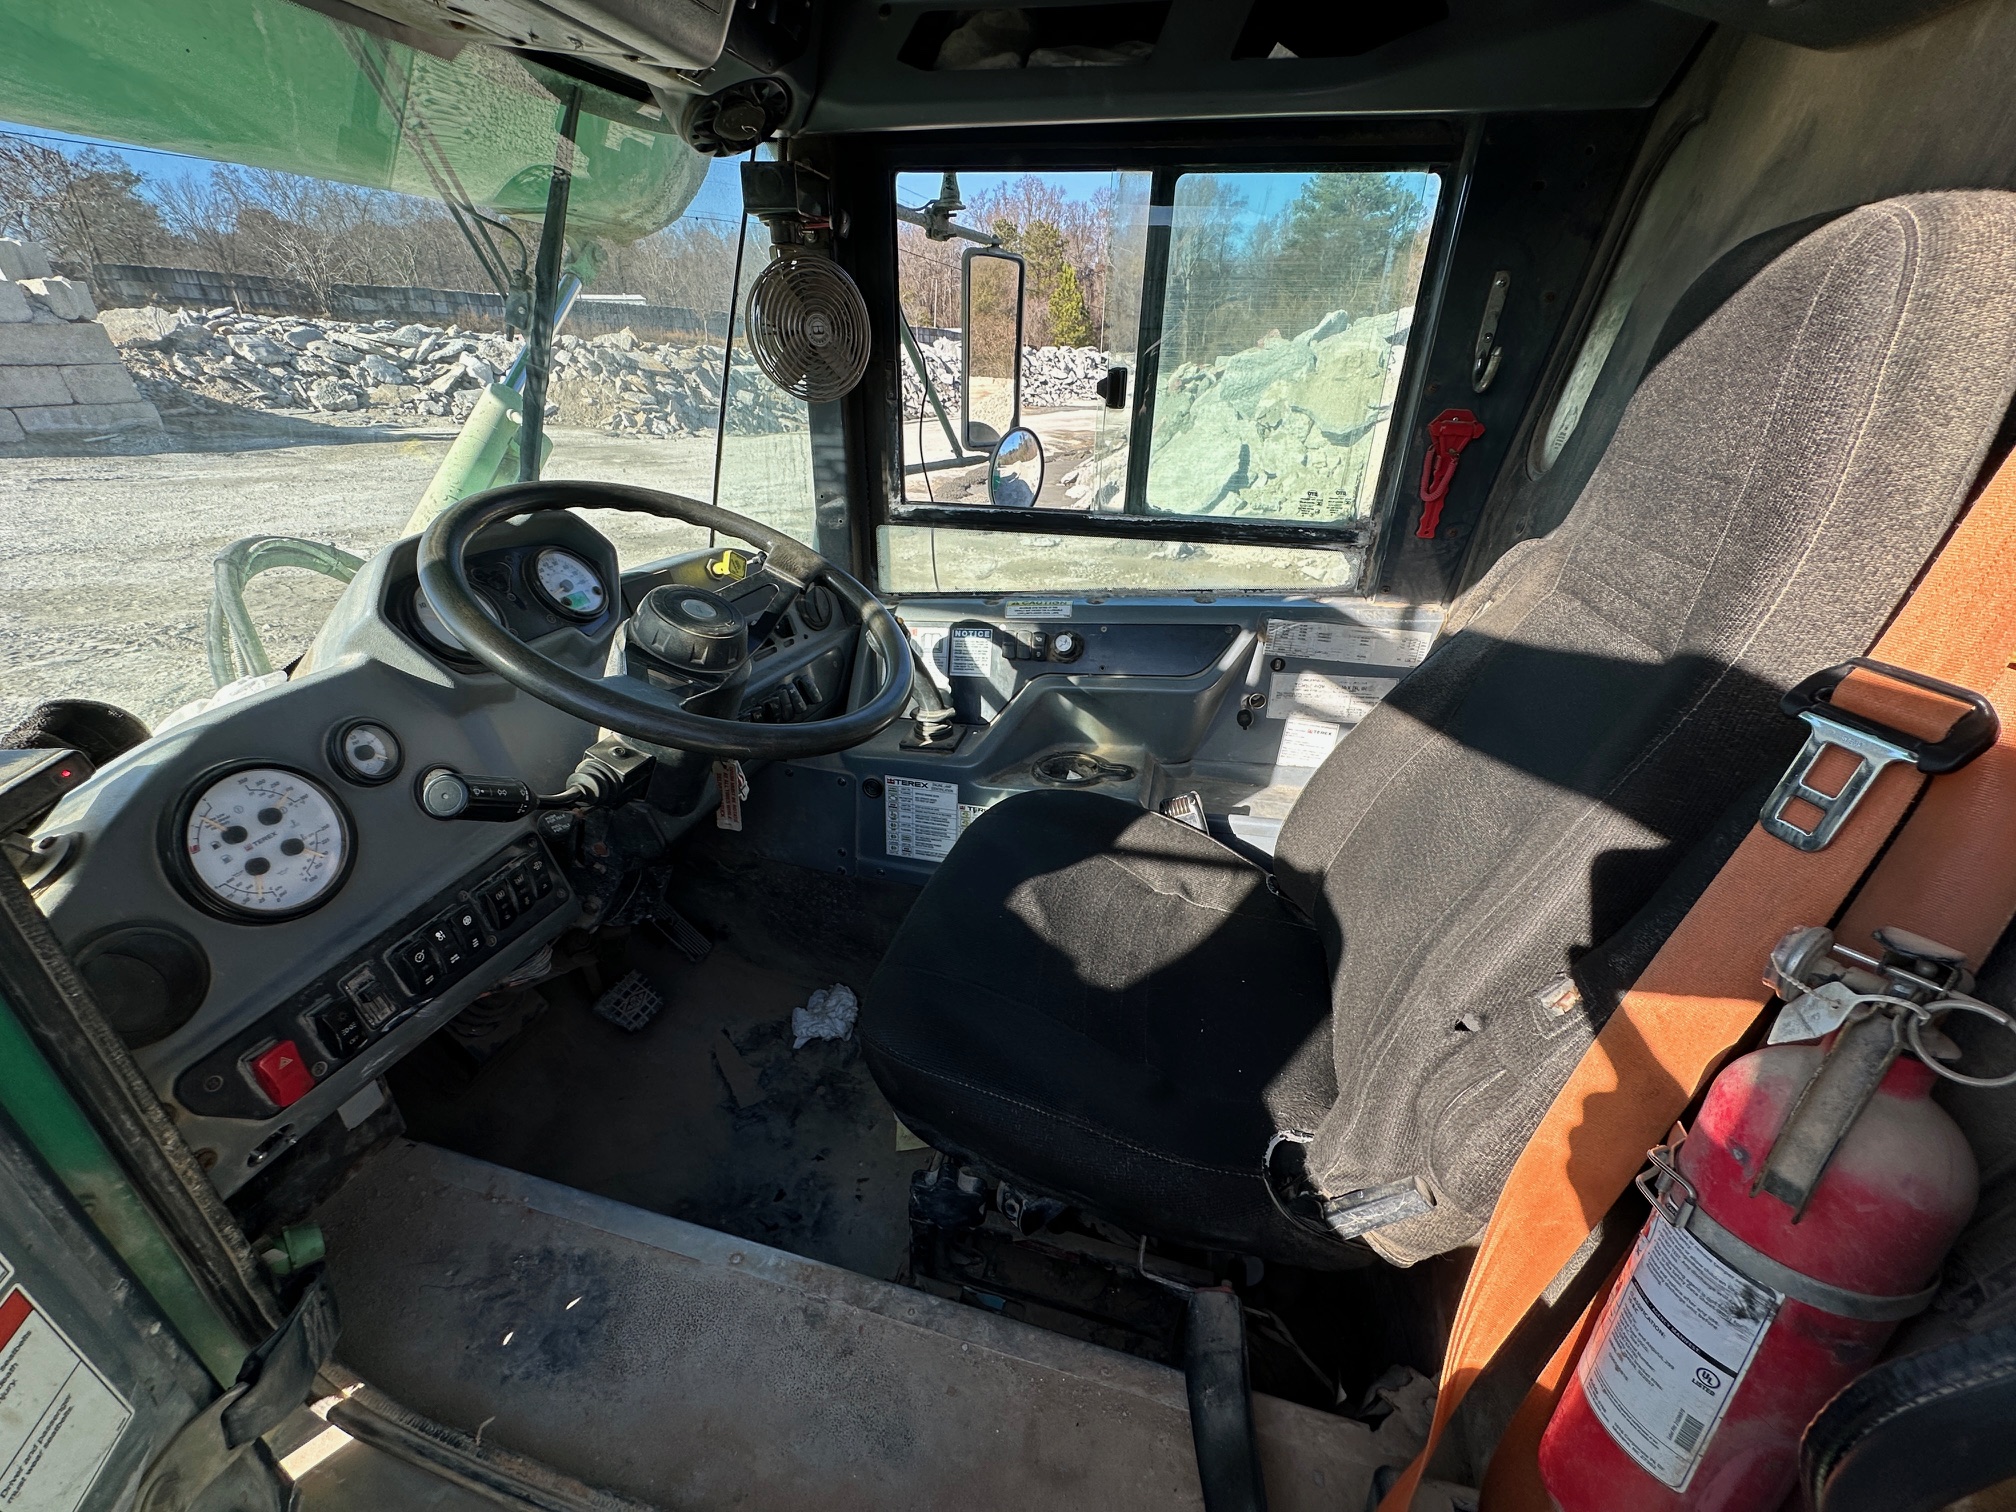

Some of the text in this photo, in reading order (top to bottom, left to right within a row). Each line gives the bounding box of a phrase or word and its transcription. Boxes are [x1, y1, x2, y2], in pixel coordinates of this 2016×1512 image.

[954, 630, 991, 639] NOTICE
[894, 778, 929, 788] TEREX
[252, 831, 279, 847] TEREX
[1628, 1289, 1667, 1339] CLASSIFICATION:
[1651, 1306, 1670, 1328] AGENCY
[0, 1329, 33, 1373] seatbelts
[1691, 1376, 1715, 1397] LISTED
[1699, 1369, 1715, 1386] UL
[0, 1392, 74, 1499] Driver and passenger
[5, 1403, 75, 1504] must wear seatbelts.
